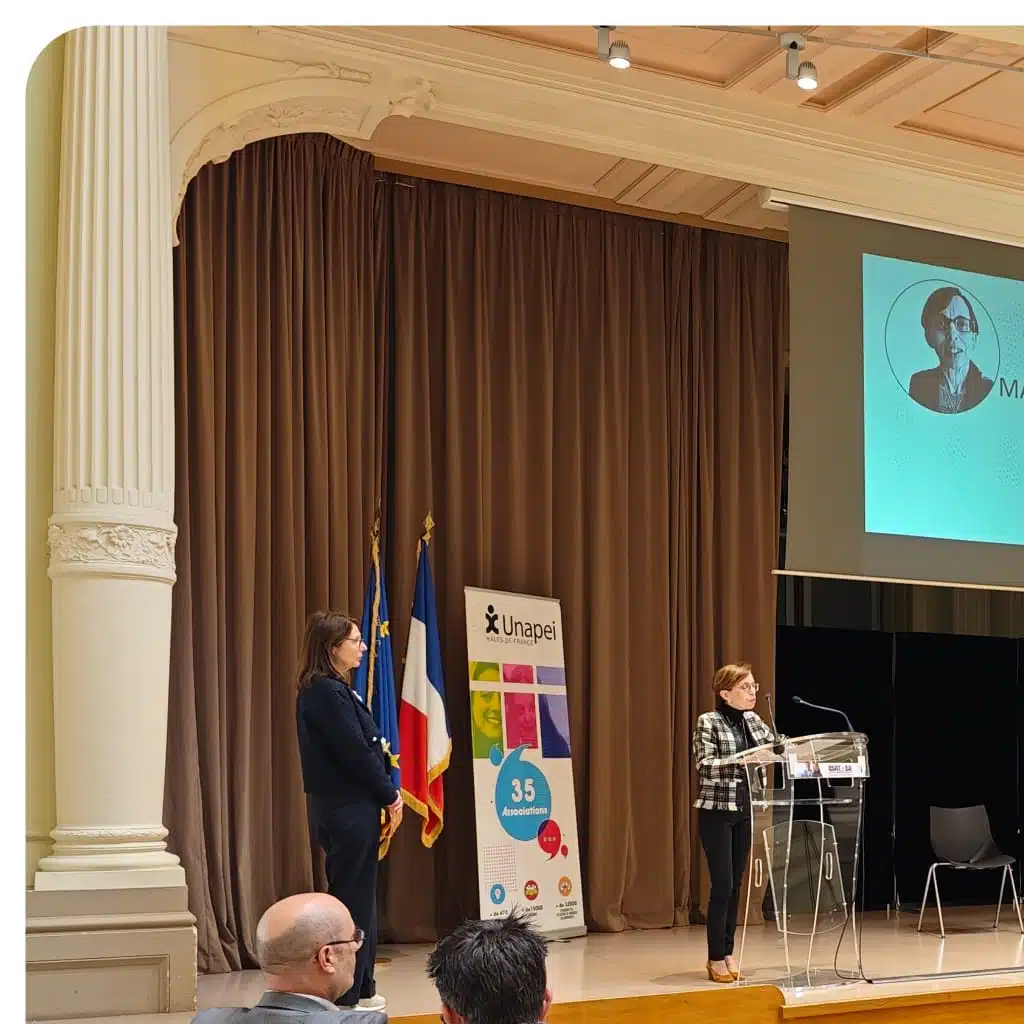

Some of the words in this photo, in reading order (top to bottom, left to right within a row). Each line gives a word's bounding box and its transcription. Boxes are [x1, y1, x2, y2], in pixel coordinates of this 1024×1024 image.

[502, 614, 557, 644] Unapei
[486, 636, 534, 646] HAUTS-DE-FRANCE
[511, 778, 536, 803] 35
[501, 805, 548, 817] Associations
